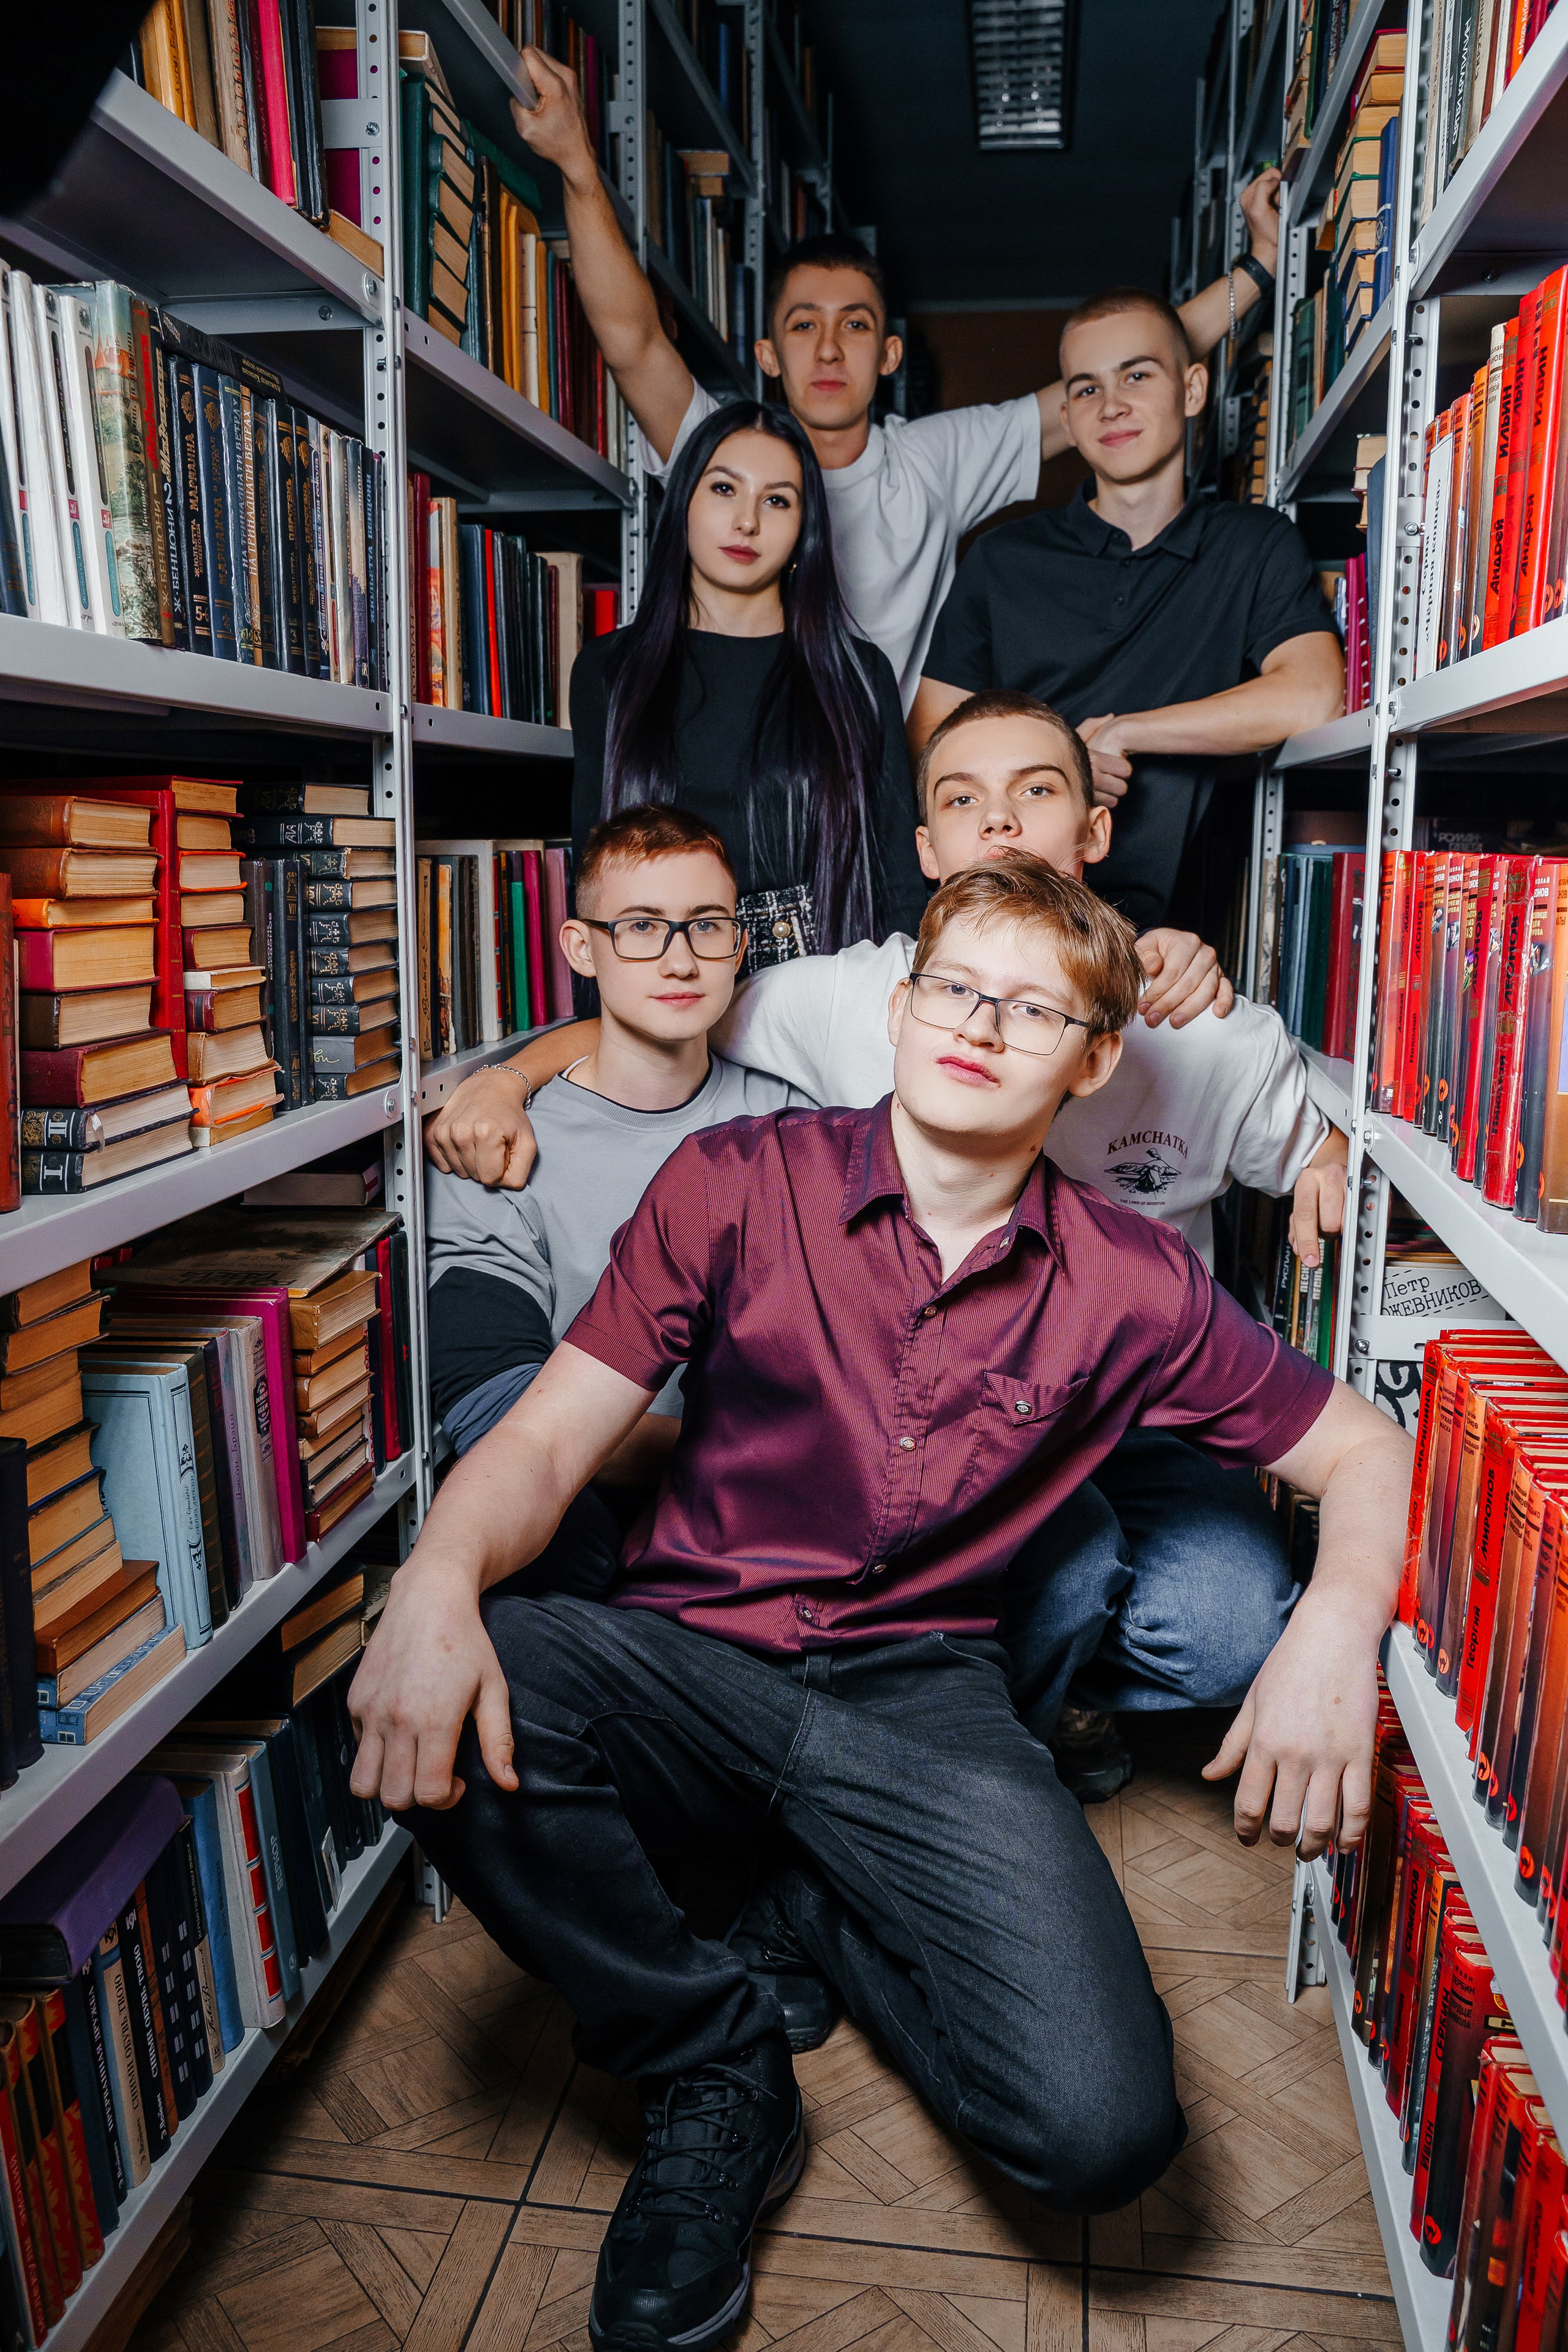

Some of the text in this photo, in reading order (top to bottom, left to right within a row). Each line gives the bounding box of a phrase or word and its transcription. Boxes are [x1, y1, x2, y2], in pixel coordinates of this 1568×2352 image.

[1452, 17, 1471, 145] СЕРГЕЙ КРУТИЛИН
[243, 410, 253, 459] ВЕТРАХ
[1510, 357, 1525, 435] ИЛЬИН
[164, 482, 173, 505] 2
[184, 432, 200, 512] МАРИАННА
[1489, 385, 1512, 596] Андрей ИЛЬИН
[1520, 345, 1548, 578] Андрей ИЛЬИН
[245, 463, 257, 554] ТРИНАДЦАТИ
[1431, 477, 1442, 555] кошка»
[249, 557, 257, 576] НА
[1420, 534, 1430, 596] Серия
[1409, 900, 1424, 1064] Николай ЛЕОНОВ
[1472, 909, 1483, 996] ЛЕОНОВ
[1504, 915, 1520, 1007] ЛЕОНОВ
[1106, 1129, 1189, 1159] KAMCHATKA
[1300, 1264, 1310, 1294] ПЕСН
[1312, 1267, 1323, 1300] ПЕСНЬ
[1384, 1275, 1430, 1300] Петр
[228, 1412, 239, 1458] Брэйн
[1417, 1387, 1432, 1474] МАРИНИНА
[1439, 1422, 1452, 1434] МАСКА
[1465, 1466, 1496, 1670] Георгий МИРОНОВ
[270, 1834, 284, 1892] ВЕРКОР
[1405, 1868, 1420, 1954] СЕМЕНОВ
[134, 1943, 159, 2079] СНИМИ ОБУВЬ ТВОЮ
[1454, 1964, 1473, 1983] Иван
[88, 1984, 115, 2133] ПРЕРВАННАЯ ДРУЖБА
[114, 1973, 140, 2111] СНИМИ ОБУВЬ ТВОЮ
[1420, 1986, 1450, 2173] Иван СЕРБИН
